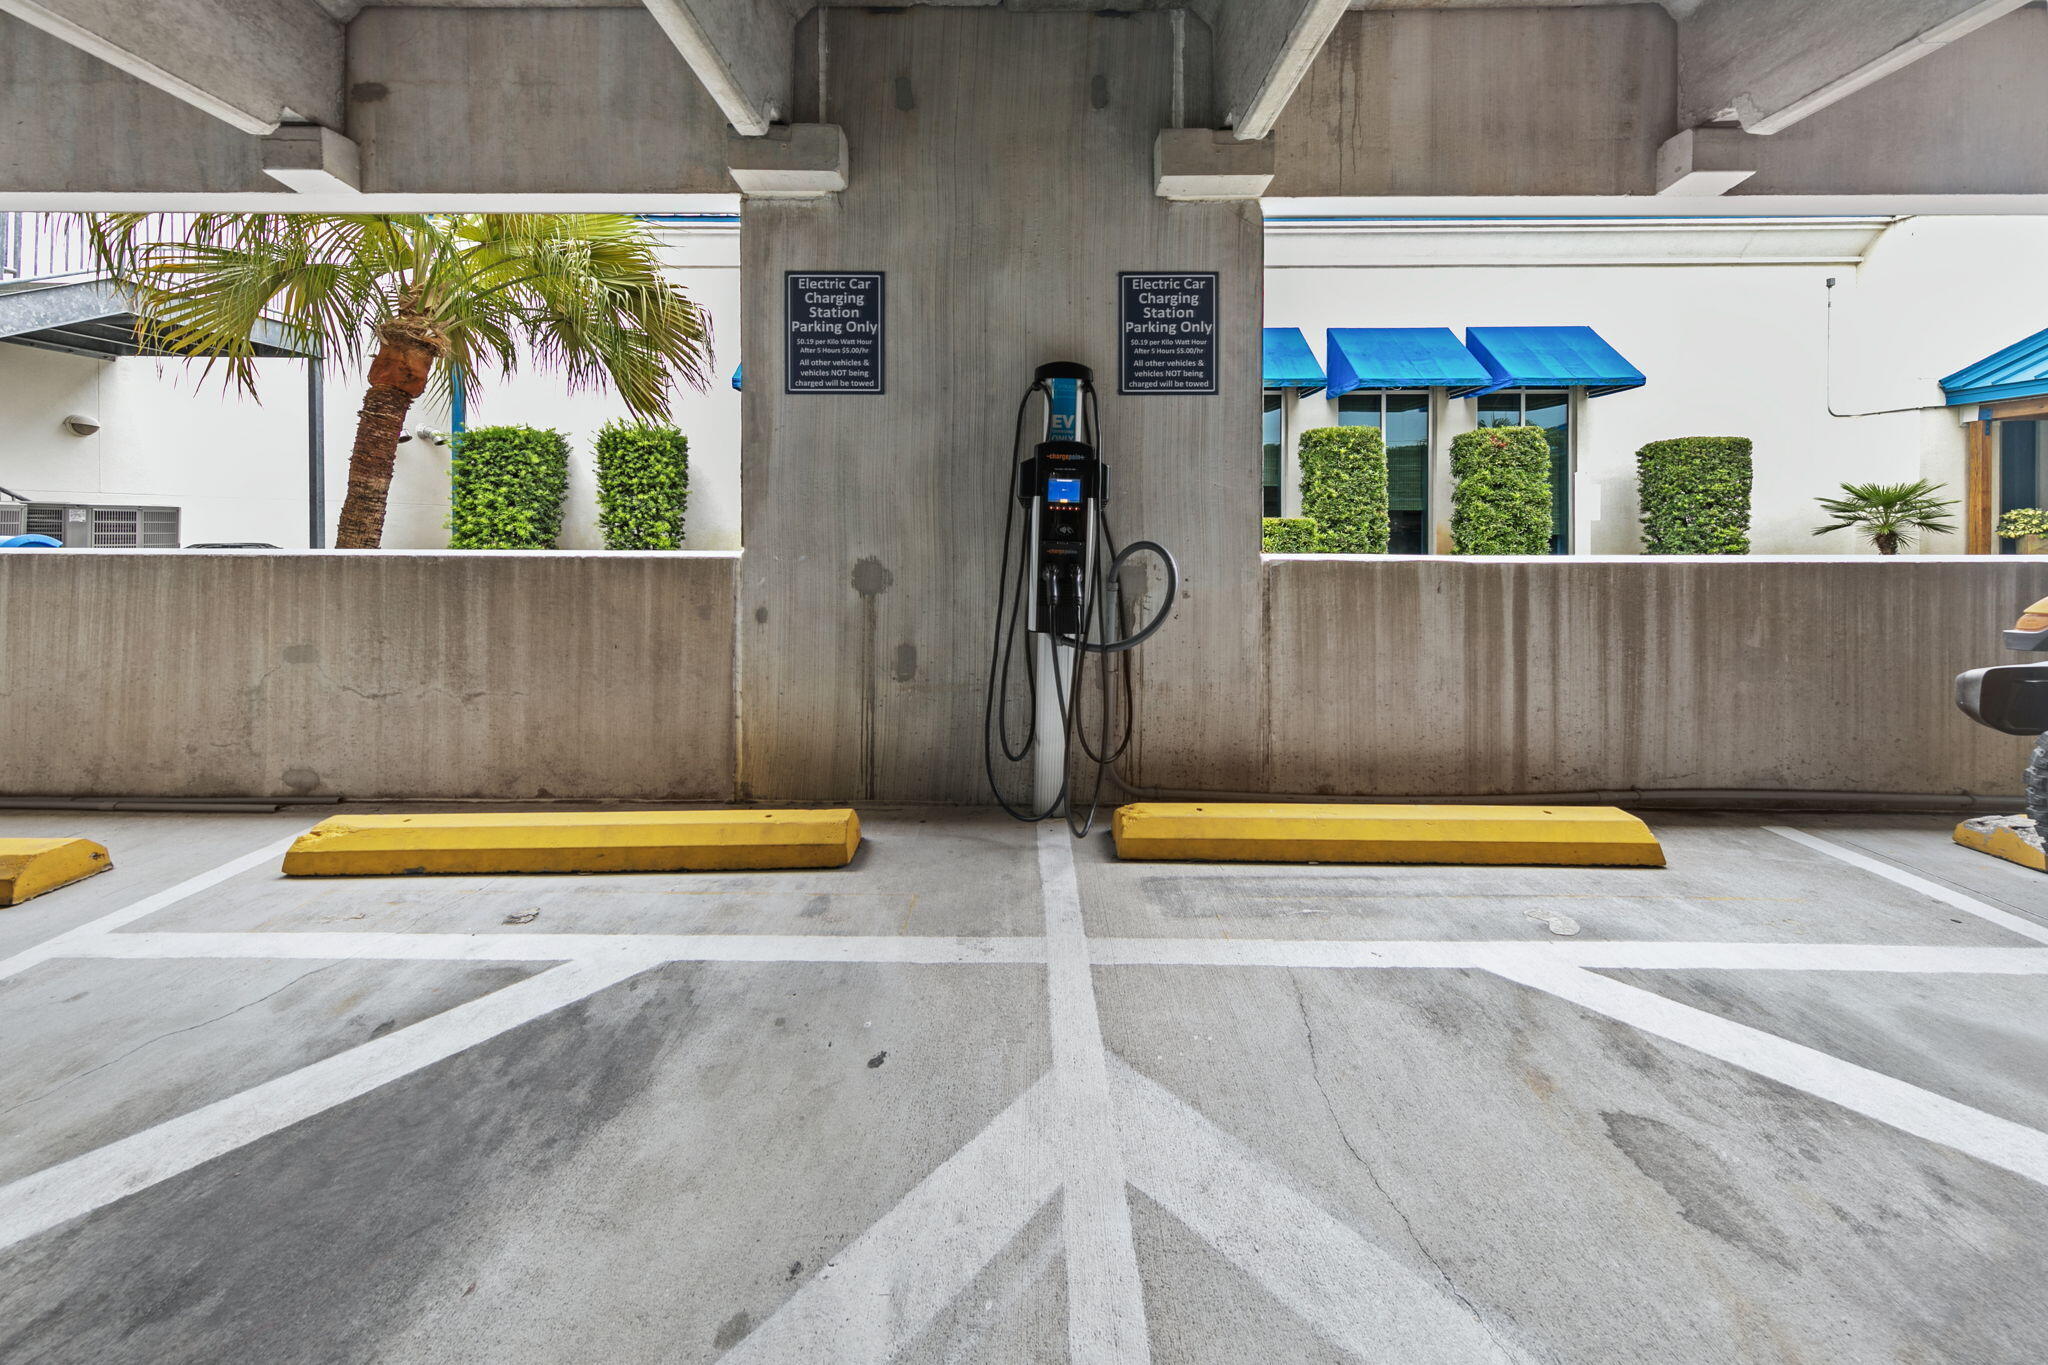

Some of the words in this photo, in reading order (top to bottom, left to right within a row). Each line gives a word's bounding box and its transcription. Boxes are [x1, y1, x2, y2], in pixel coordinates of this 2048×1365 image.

[799, 278, 845, 289] Electric
[849, 279, 871, 289] Car
[1133, 279, 1180, 289] Electric
[1184, 279, 1205, 289] Car
[805, 292, 864, 306] Charging
[1139, 292, 1199, 306] Charging
[809, 307, 859, 317] Station
[1143, 307, 1194, 318] Station
[792, 321, 842, 334] Parking
[846, 321, 877, 335] Only
[1126, 322, 1177, 335] Parking
[1181, 321, 1212, 335] Only
[1052, 414, 1075, 428] EV
